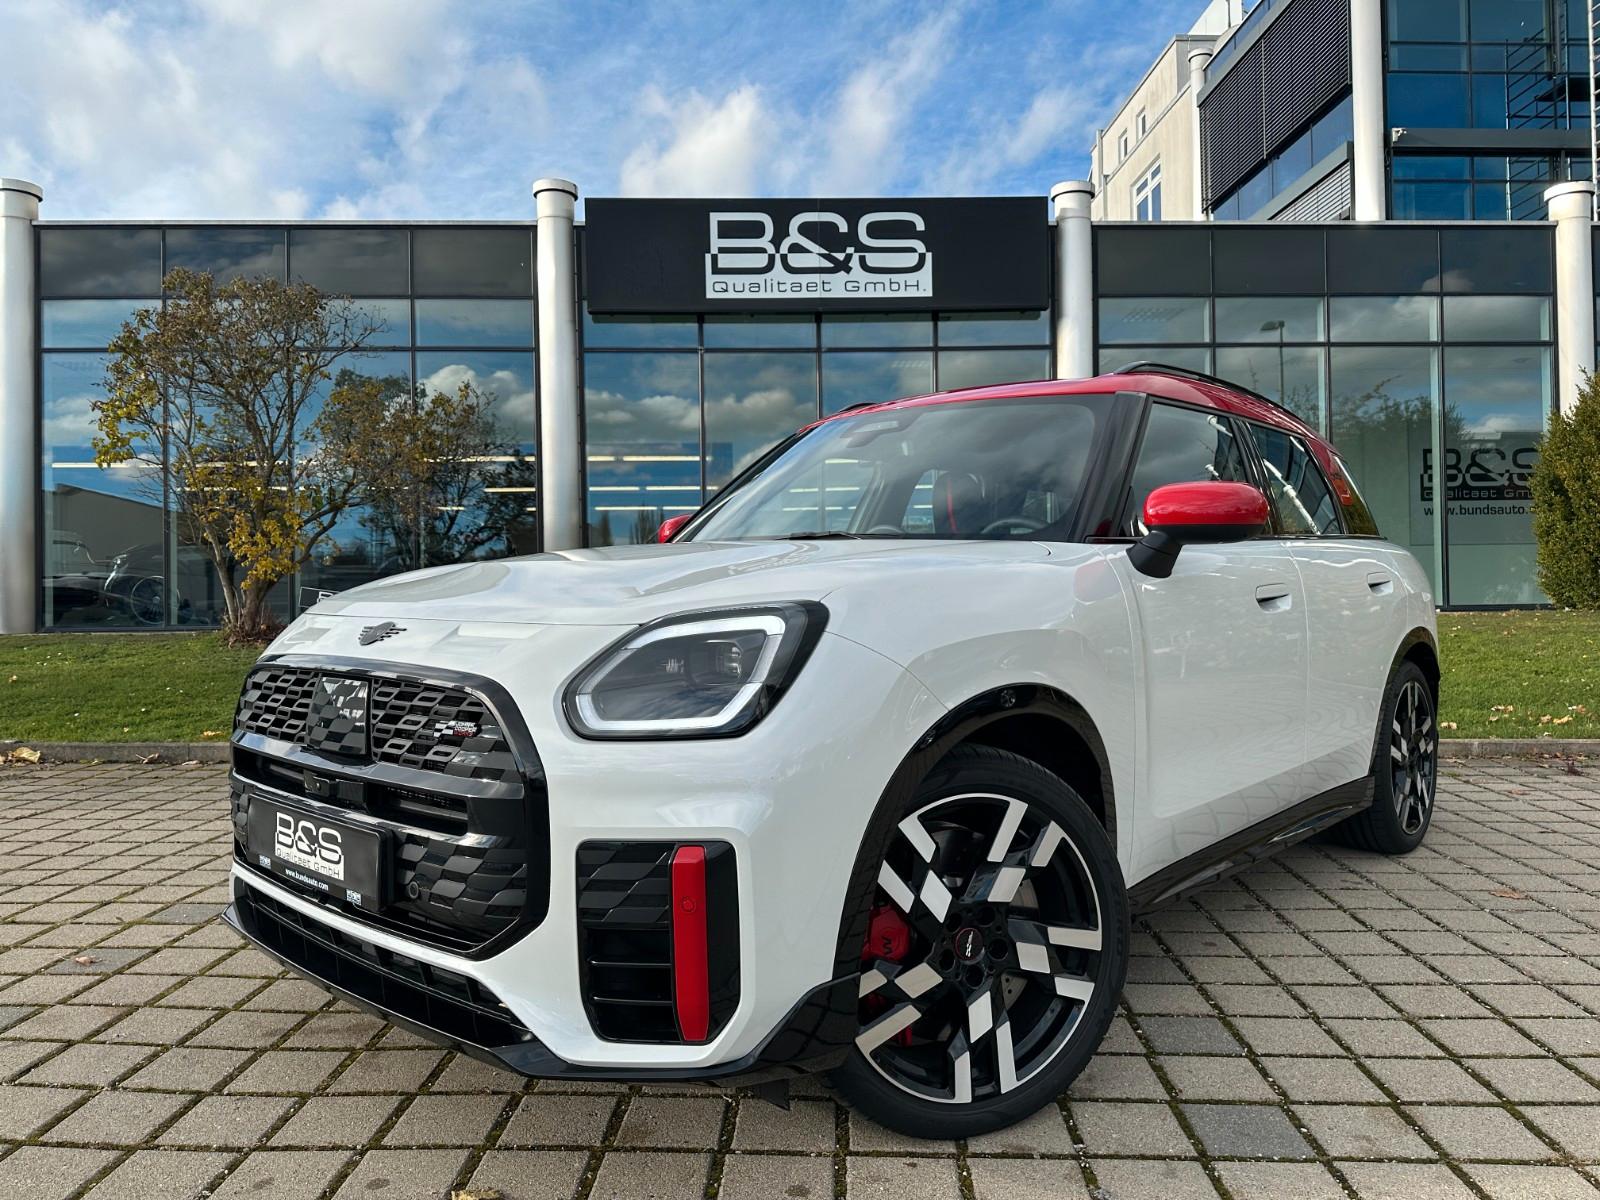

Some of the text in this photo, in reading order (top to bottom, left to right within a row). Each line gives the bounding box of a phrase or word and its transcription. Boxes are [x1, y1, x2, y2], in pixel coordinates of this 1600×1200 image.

[709, 212, 927, 275] B&S
[713, 279, 831, 294] Qualitaet
[1424, 489, 1496, 498] Qalitaet
[277, 812, 342, 865] B&S
